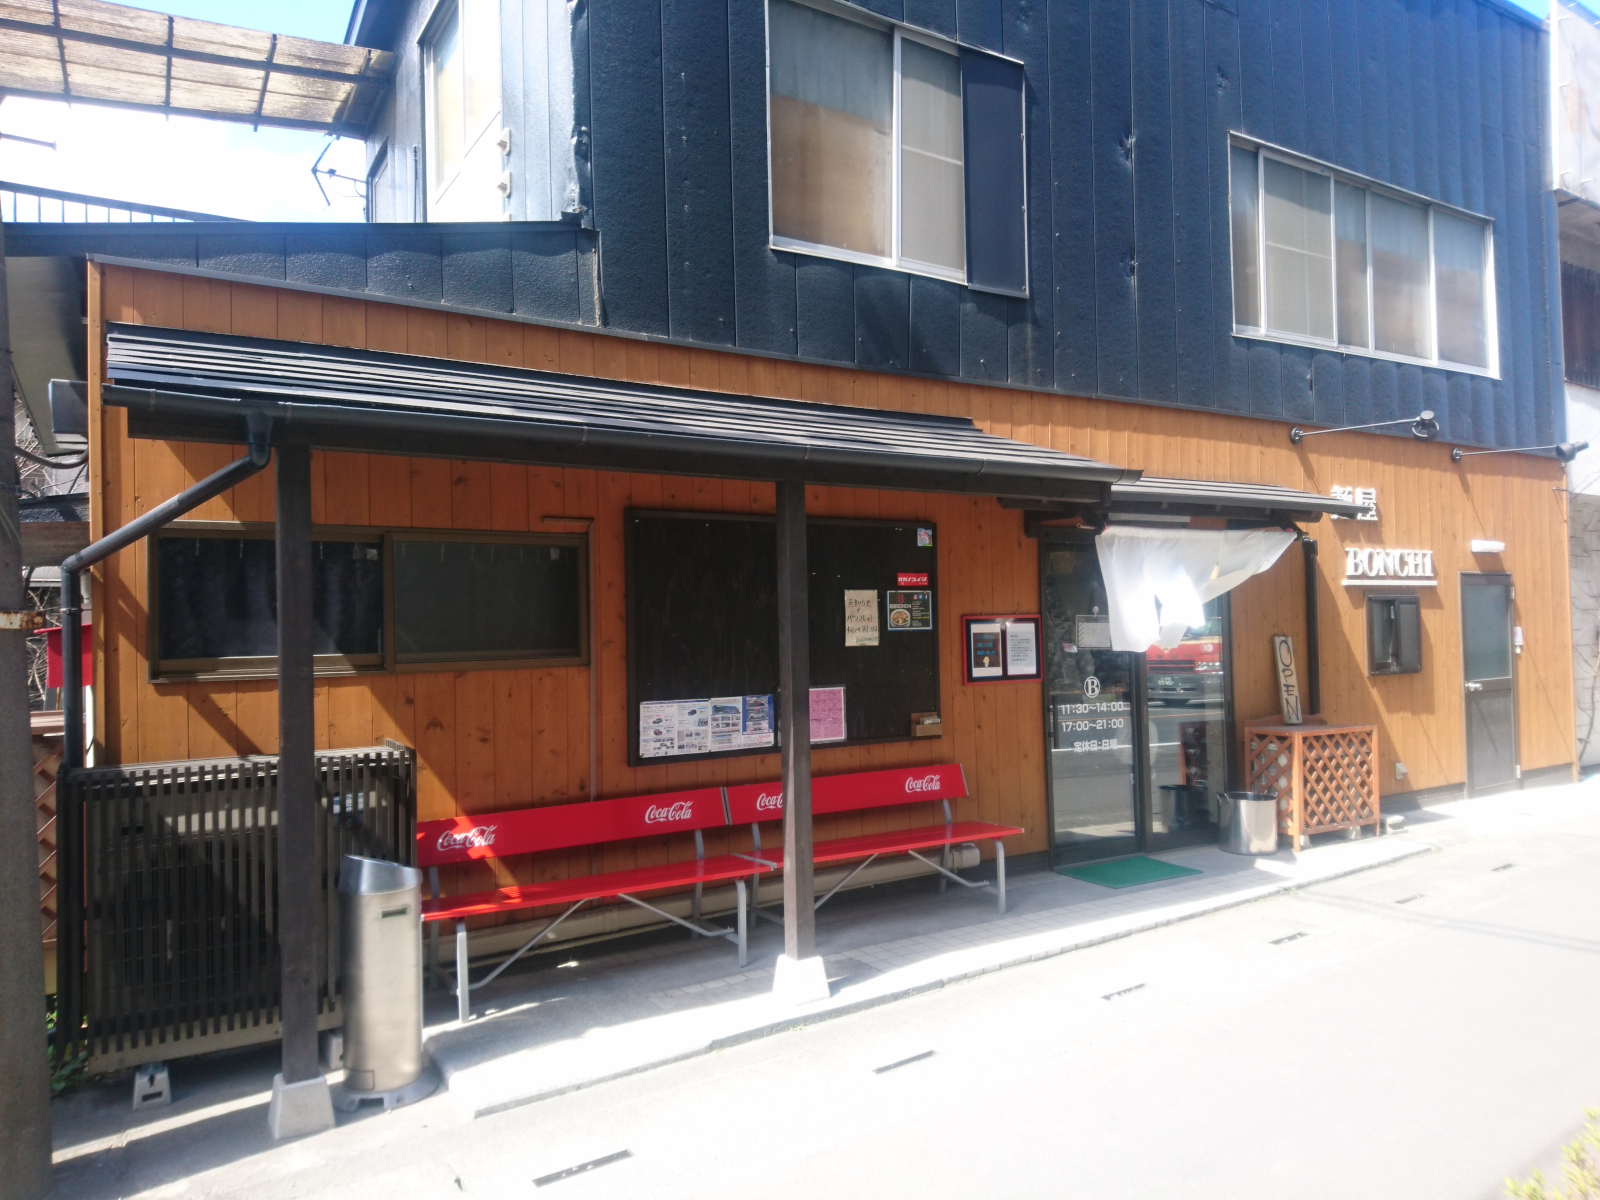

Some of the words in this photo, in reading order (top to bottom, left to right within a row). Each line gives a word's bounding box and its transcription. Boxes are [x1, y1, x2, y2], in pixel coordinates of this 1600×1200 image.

[1345, 547, 1433, 577] BONCHI
[1086, 678, 1099, 697] B
[1278, 639, 1300, 721] OPEN
[1061, 702, 1124, 715] 11:30~14:00
[1061, 718, 1124, 732] 17:00~21:00
[905, 774, 941, 793] Coca-Cola
[645, 801, 694, 824] Coca-Cola
[436, 825, 498, 852] Coca-Cola
